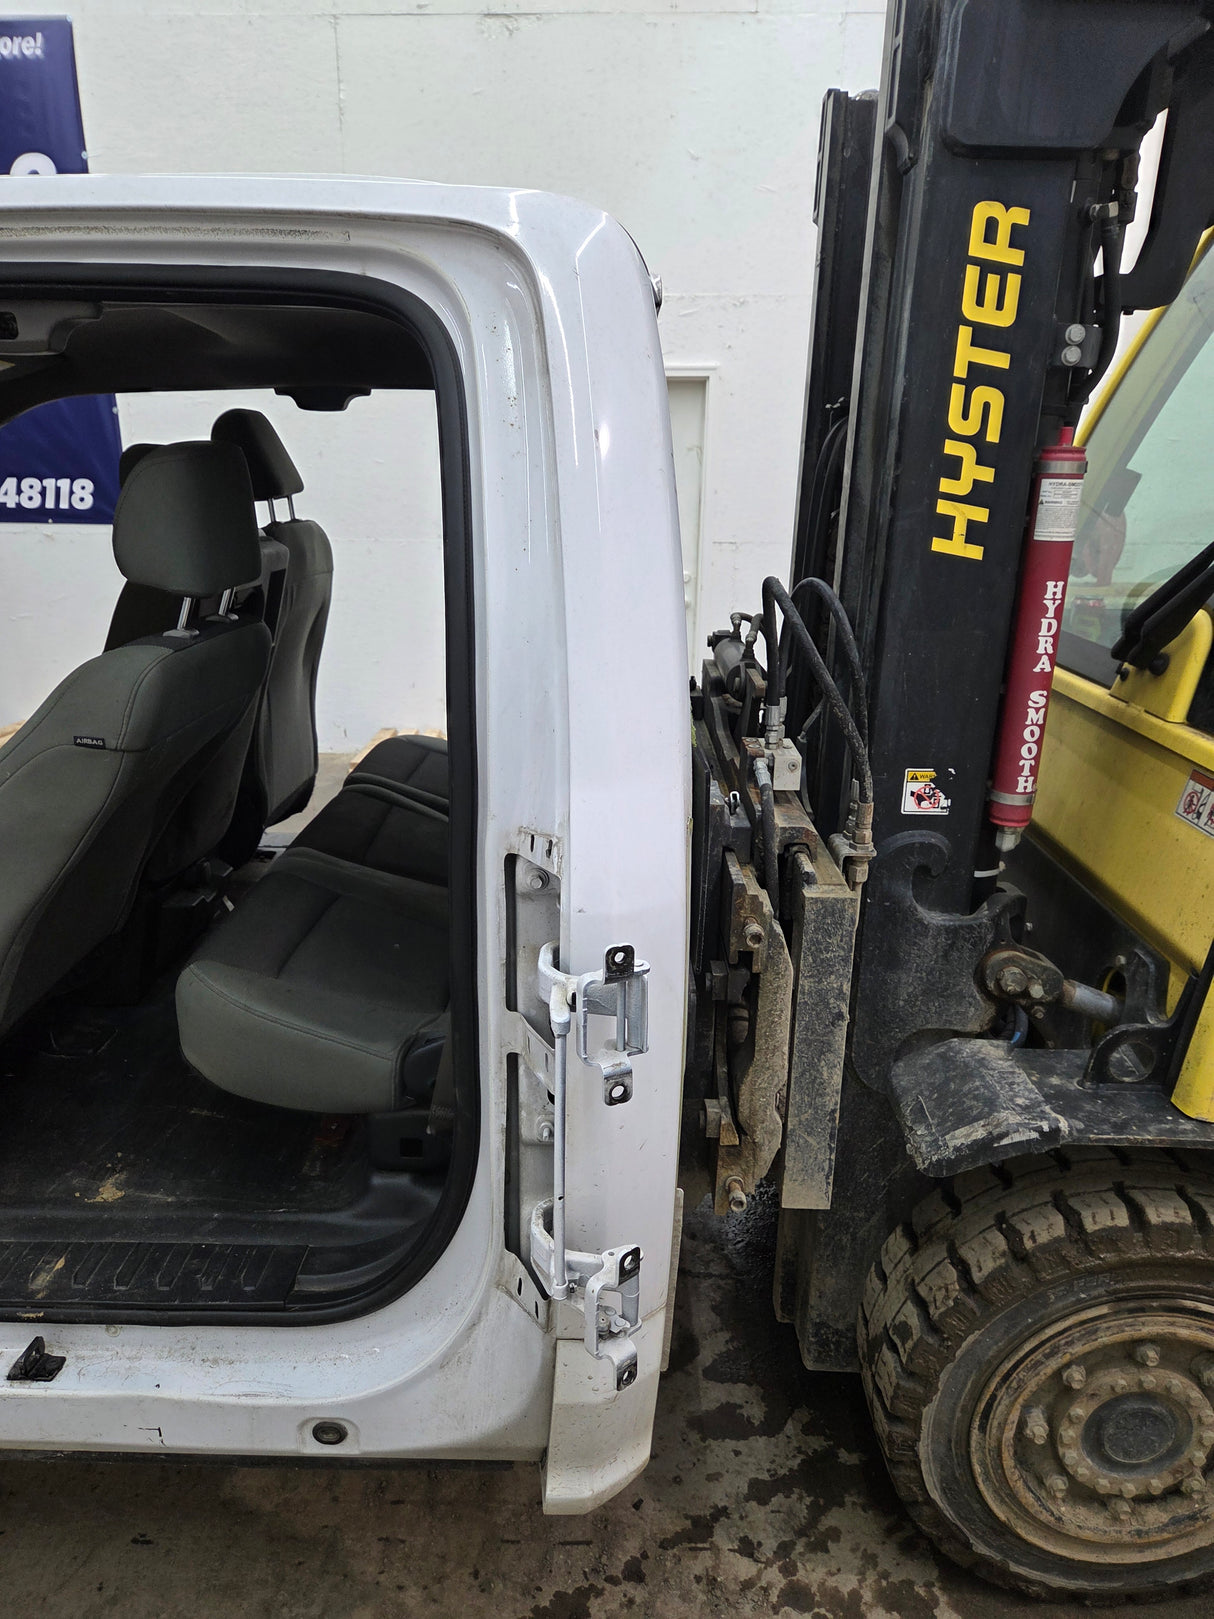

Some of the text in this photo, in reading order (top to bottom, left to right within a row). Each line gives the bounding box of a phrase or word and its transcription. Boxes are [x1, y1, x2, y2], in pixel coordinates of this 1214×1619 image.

[931, 200, 1031, 561] HYSTER
[0, 477, 95, 510] 48118
[76, 738, 104, 746] AIRBAG
[1016, 580, 1065, 793] HYDRA SMOOTH
